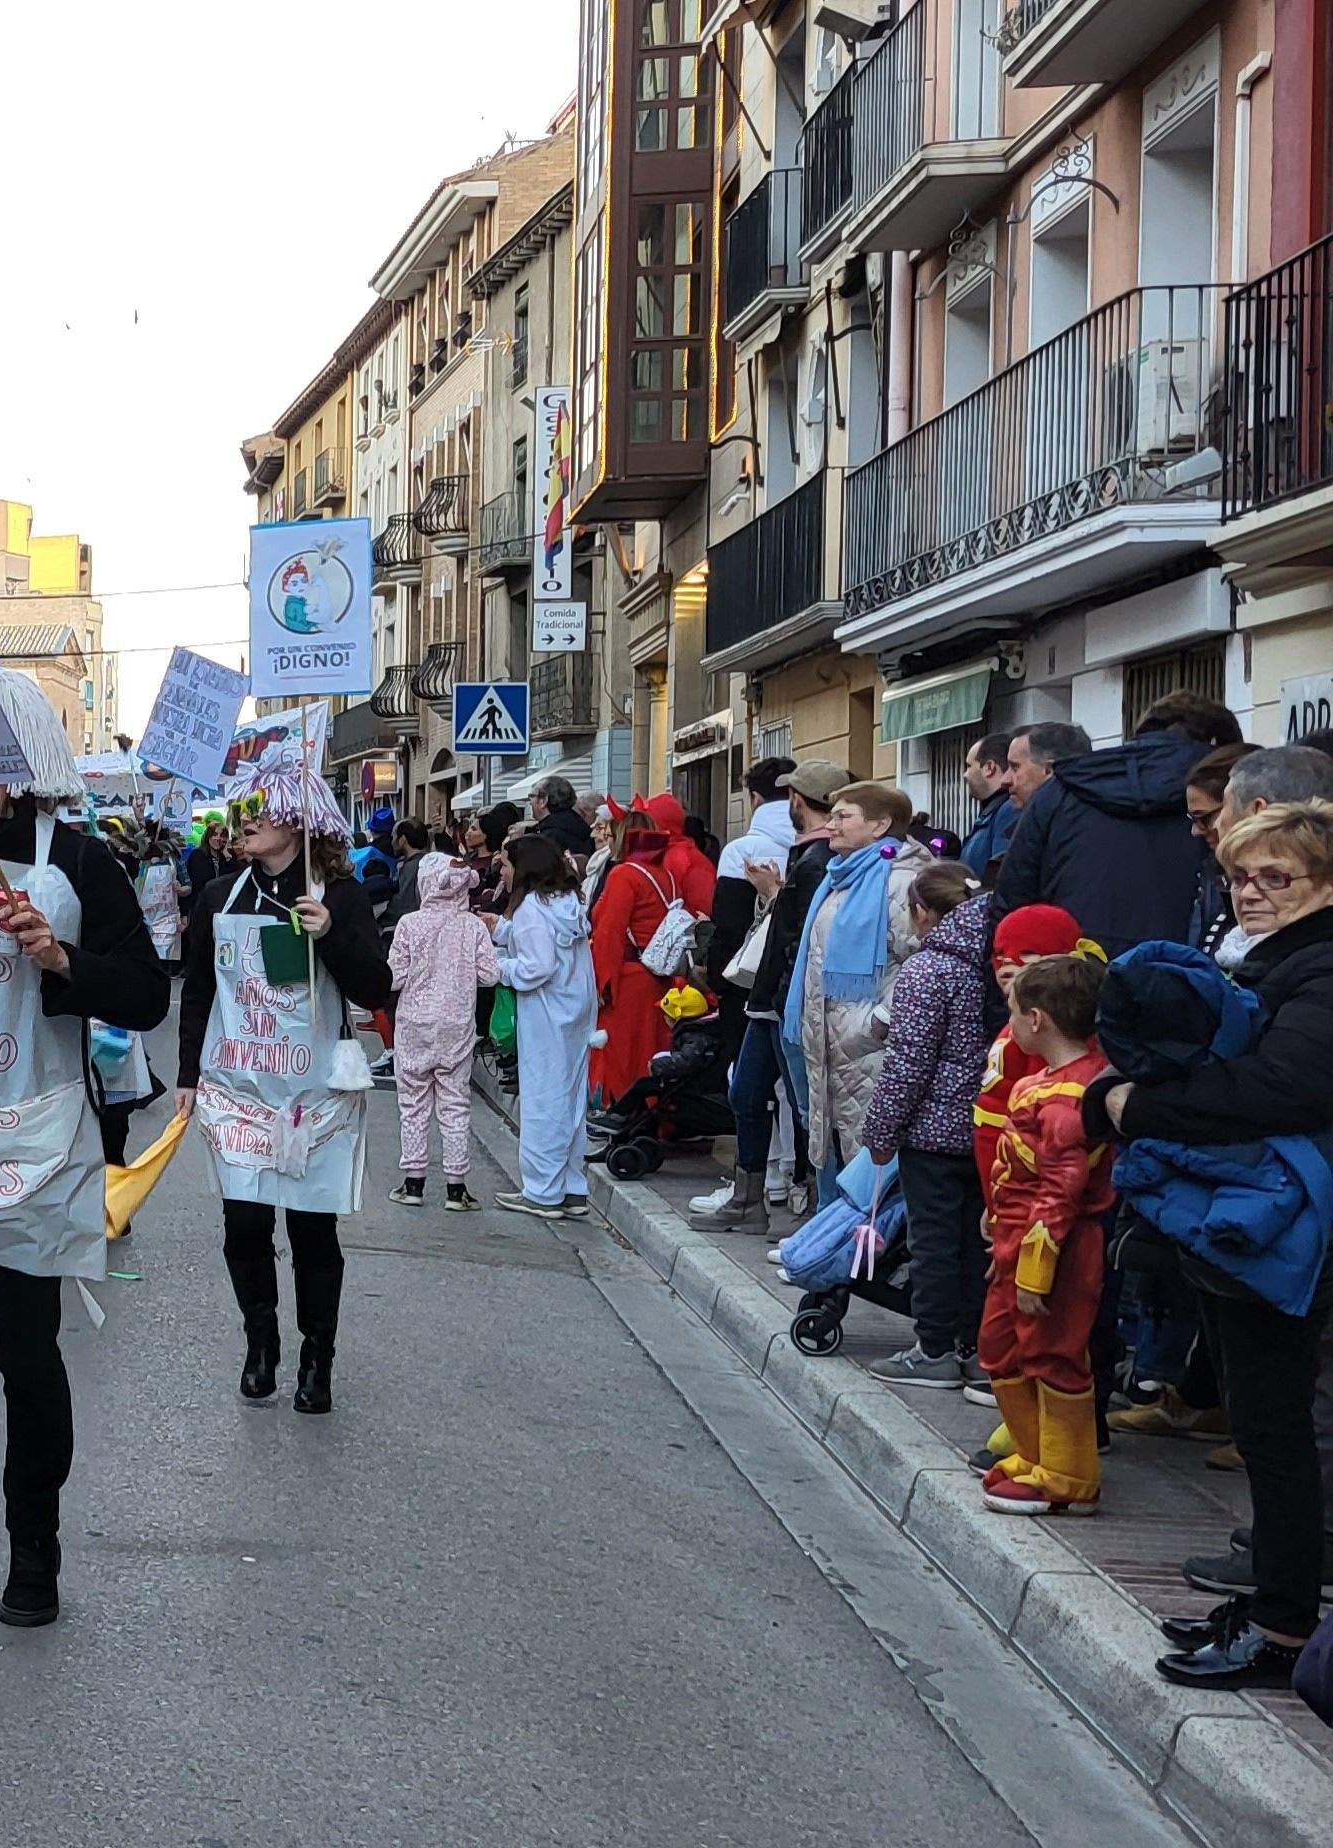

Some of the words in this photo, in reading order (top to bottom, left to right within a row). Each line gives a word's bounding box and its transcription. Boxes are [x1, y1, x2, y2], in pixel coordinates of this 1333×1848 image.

[544, 608, 576, 617] Comida
[537, 620, 583, 629] Tradicional
[267, 647, 286, 655] POR
[273, 652, 350, 674] ¡DIGNO!
[235, 977, 296, 1012] AÑOS
[240, 1010, 276, 1038] SIN
